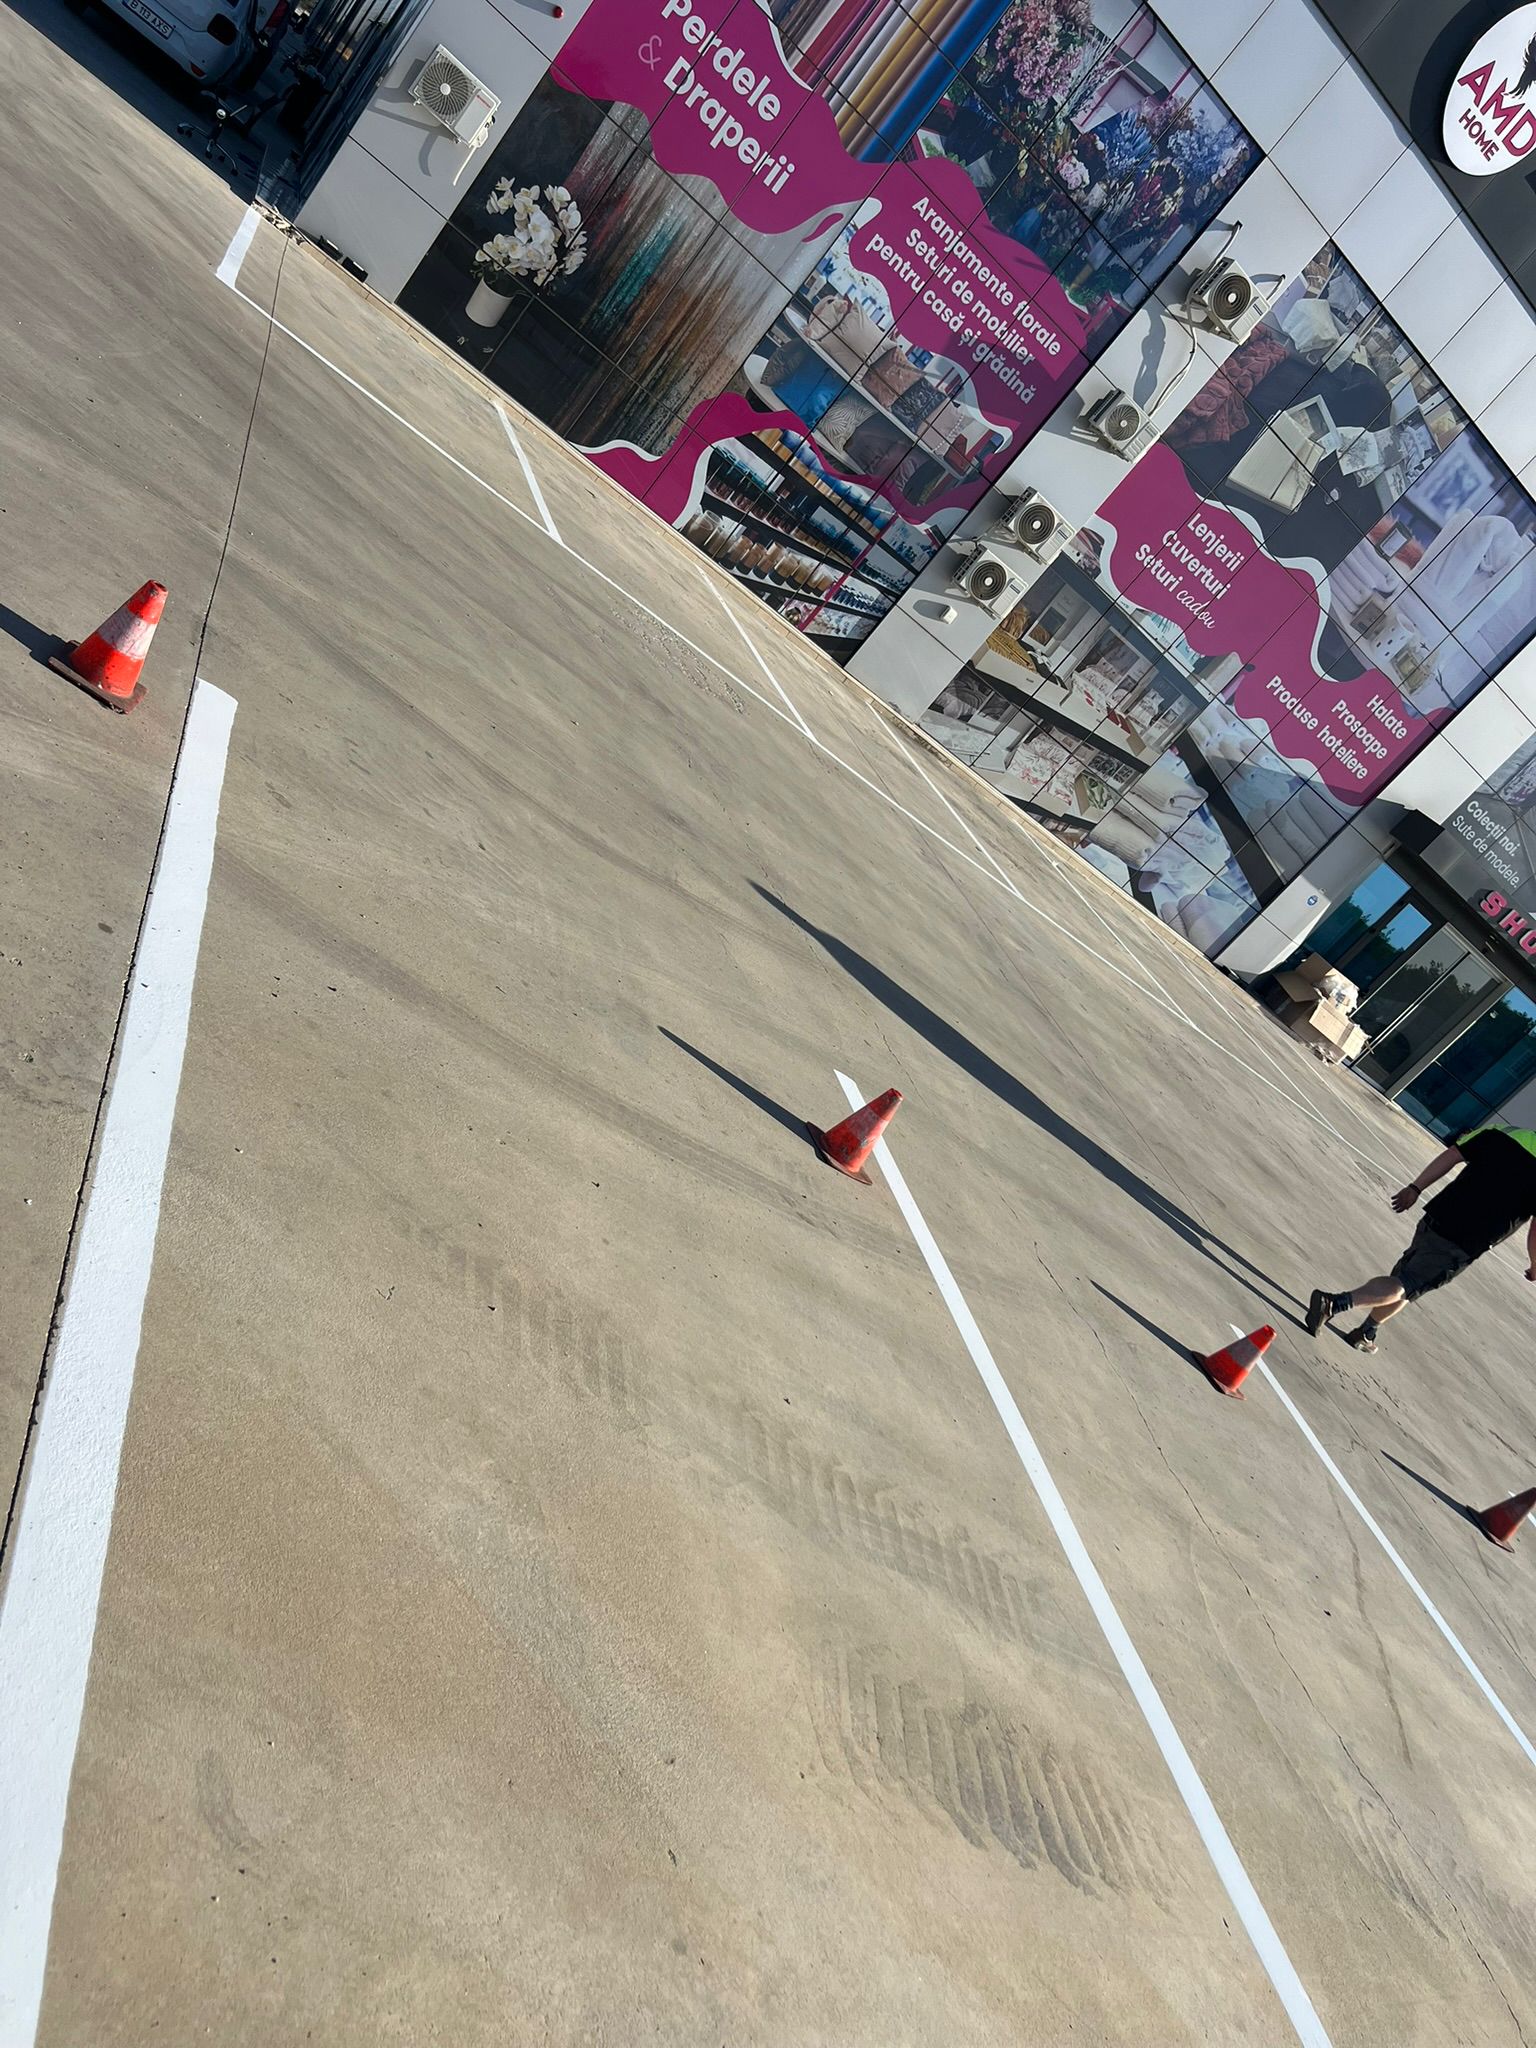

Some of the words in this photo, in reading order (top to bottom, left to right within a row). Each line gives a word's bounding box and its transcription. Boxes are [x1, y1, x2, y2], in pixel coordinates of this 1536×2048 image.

[140, 6, 152, 20] 113
[151, 18, 170, 34] AXS
[661, 0, 781, 121] Perdele
[663, 56, 795, 194] Draperii
[1457, 60, 1536, 157] AMD
[1458, 108, 1500, 162] HOME
[906, 228, 958, 284] Seturi
[951, 280, 974, 304] de
[971, 300, 1036, 366] mobilier
[912, 196, 1014, 306] Aranjamente
[1012, 300, 1061, 356] florale
[865, 233, 926, 294] pentru
[923, 289, 966, 333] casă
[958, 328, 982, 347] și
[972, 342, 1037, 404] grădină
[1162, 530, 1232, 600] Cuverturi
[1187, 512, 1245, 572] Lenjerii
[1135, 544, 1184, 592] Seturi
[1176, 590, 1215, 629] cadou
[1266, 675, 1320, 730] Produse
[1316, 724, 1369, 780] hoteliere
[1331, 699, 1388, 760] Prosoape
[1366, 694, 1408, 739] Halate
[1452, 815, 1476, 840] Sute
[1472, 837, 1488, 854] de
[1484, 850, 1520, 888] modele.
[1467, 800, 1507, 840] Colecții
[1498, 836, 1520, 856] noi.
